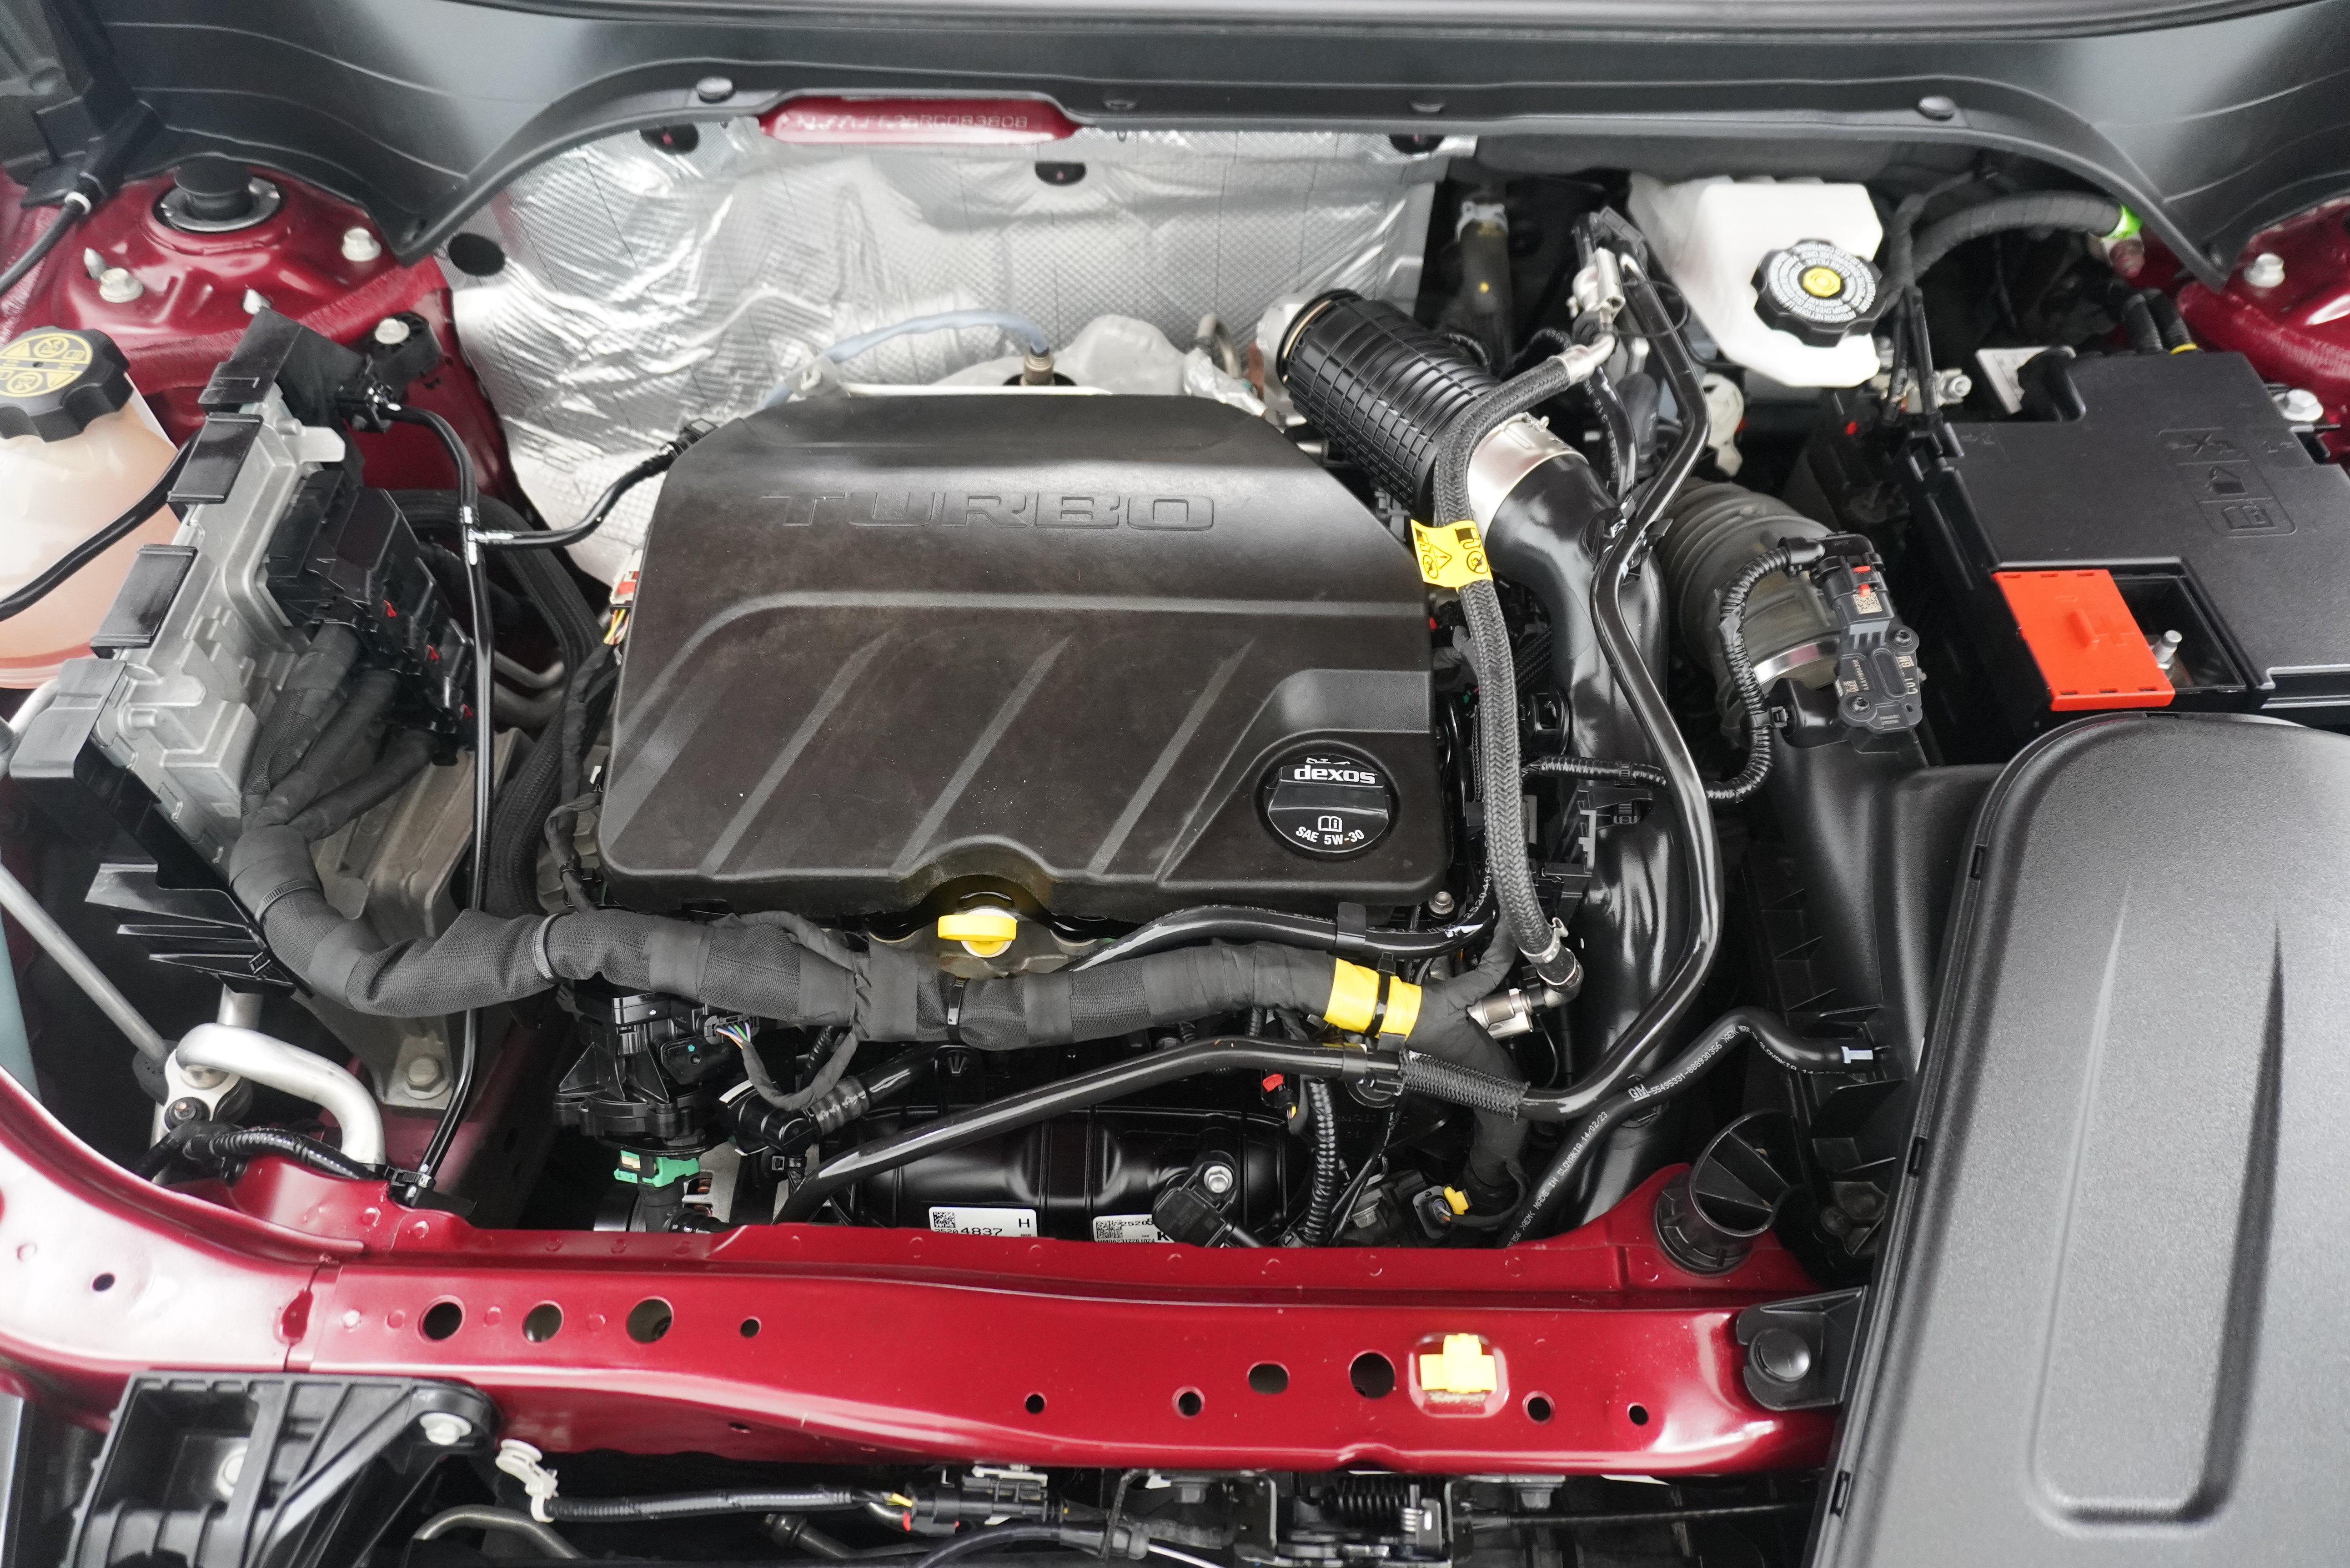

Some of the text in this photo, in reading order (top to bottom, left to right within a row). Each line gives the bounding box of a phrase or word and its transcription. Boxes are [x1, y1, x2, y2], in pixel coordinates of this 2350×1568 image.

[760, 492, 1214, 531] TURBO
[1898, 655, 1914, 668] GM
[1294, 765, 1376, 784] dexos
[1296, 826, 1365, 845] SAE 5W-30
[1533, 1189, 1550, 1210] MADE
[1548, 1177, 1559, 1188] IN
[1557, 1142, 1583, 1176] SLOVAKIA
[1581, 1111, 1608, 1142] 14/02/23
[1019, 1218, 1030, 1228] H
